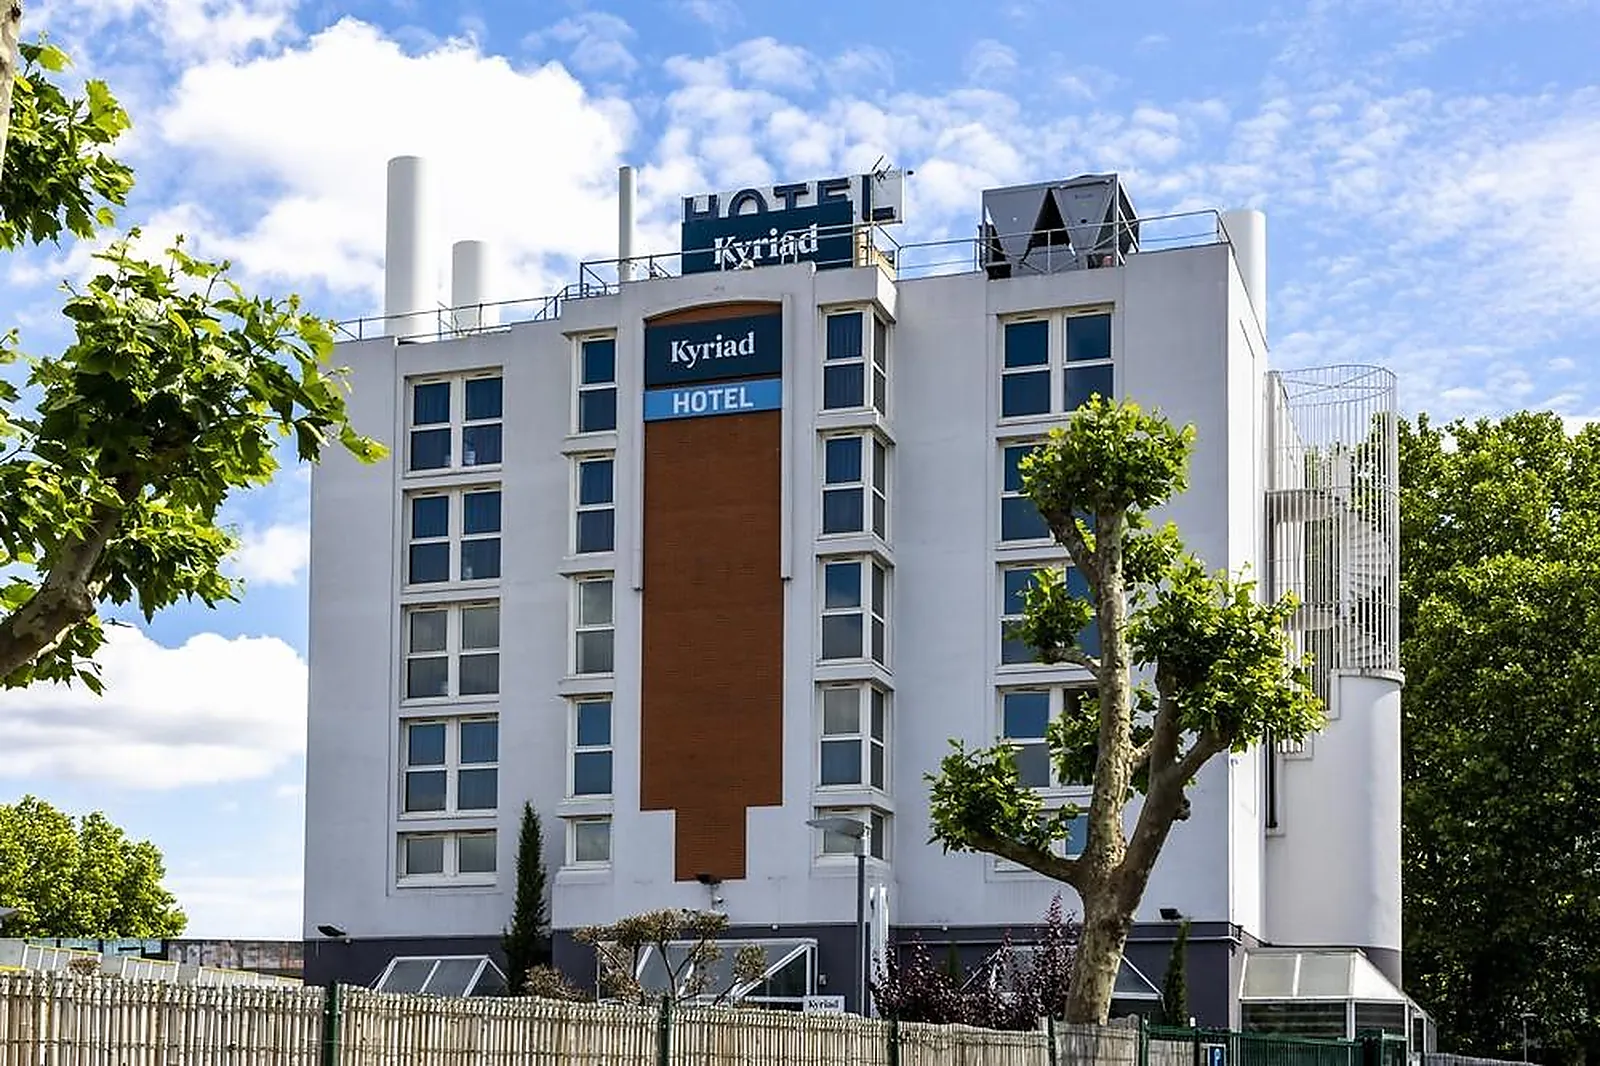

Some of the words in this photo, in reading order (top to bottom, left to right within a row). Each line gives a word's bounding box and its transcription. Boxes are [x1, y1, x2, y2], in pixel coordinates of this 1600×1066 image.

[714, 223, 819, 270] Kyriad
[671, 331, 755, 368] Kyriad
[673, 387, 754, 414] HOTEL
